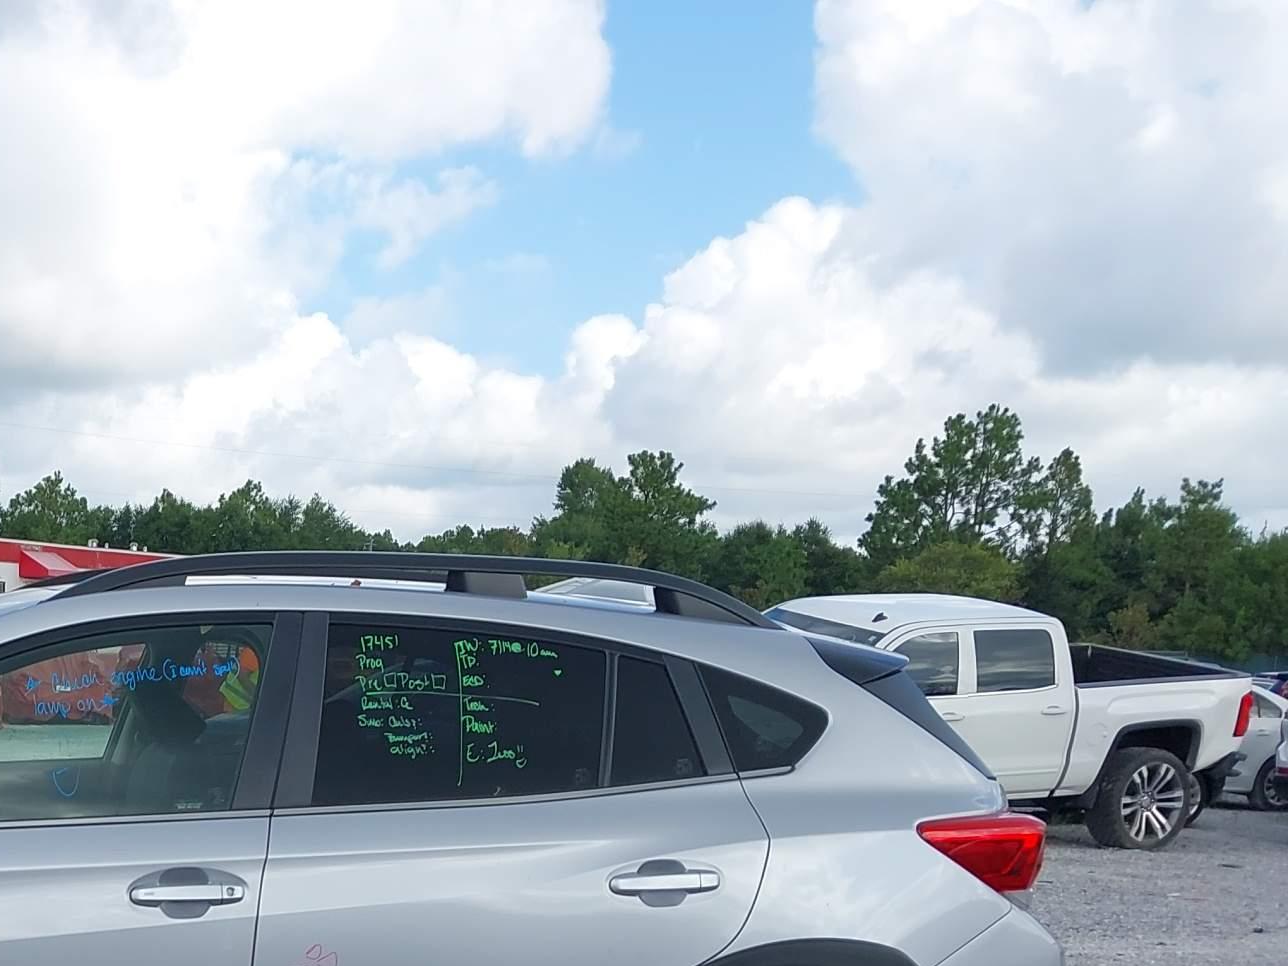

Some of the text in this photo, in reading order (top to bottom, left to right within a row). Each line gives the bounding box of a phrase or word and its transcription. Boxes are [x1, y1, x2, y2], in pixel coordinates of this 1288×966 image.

[360, 635, 399, 652] 17451
[110, 666, 163, 691] engine
[76, 696, 103, 712] on
